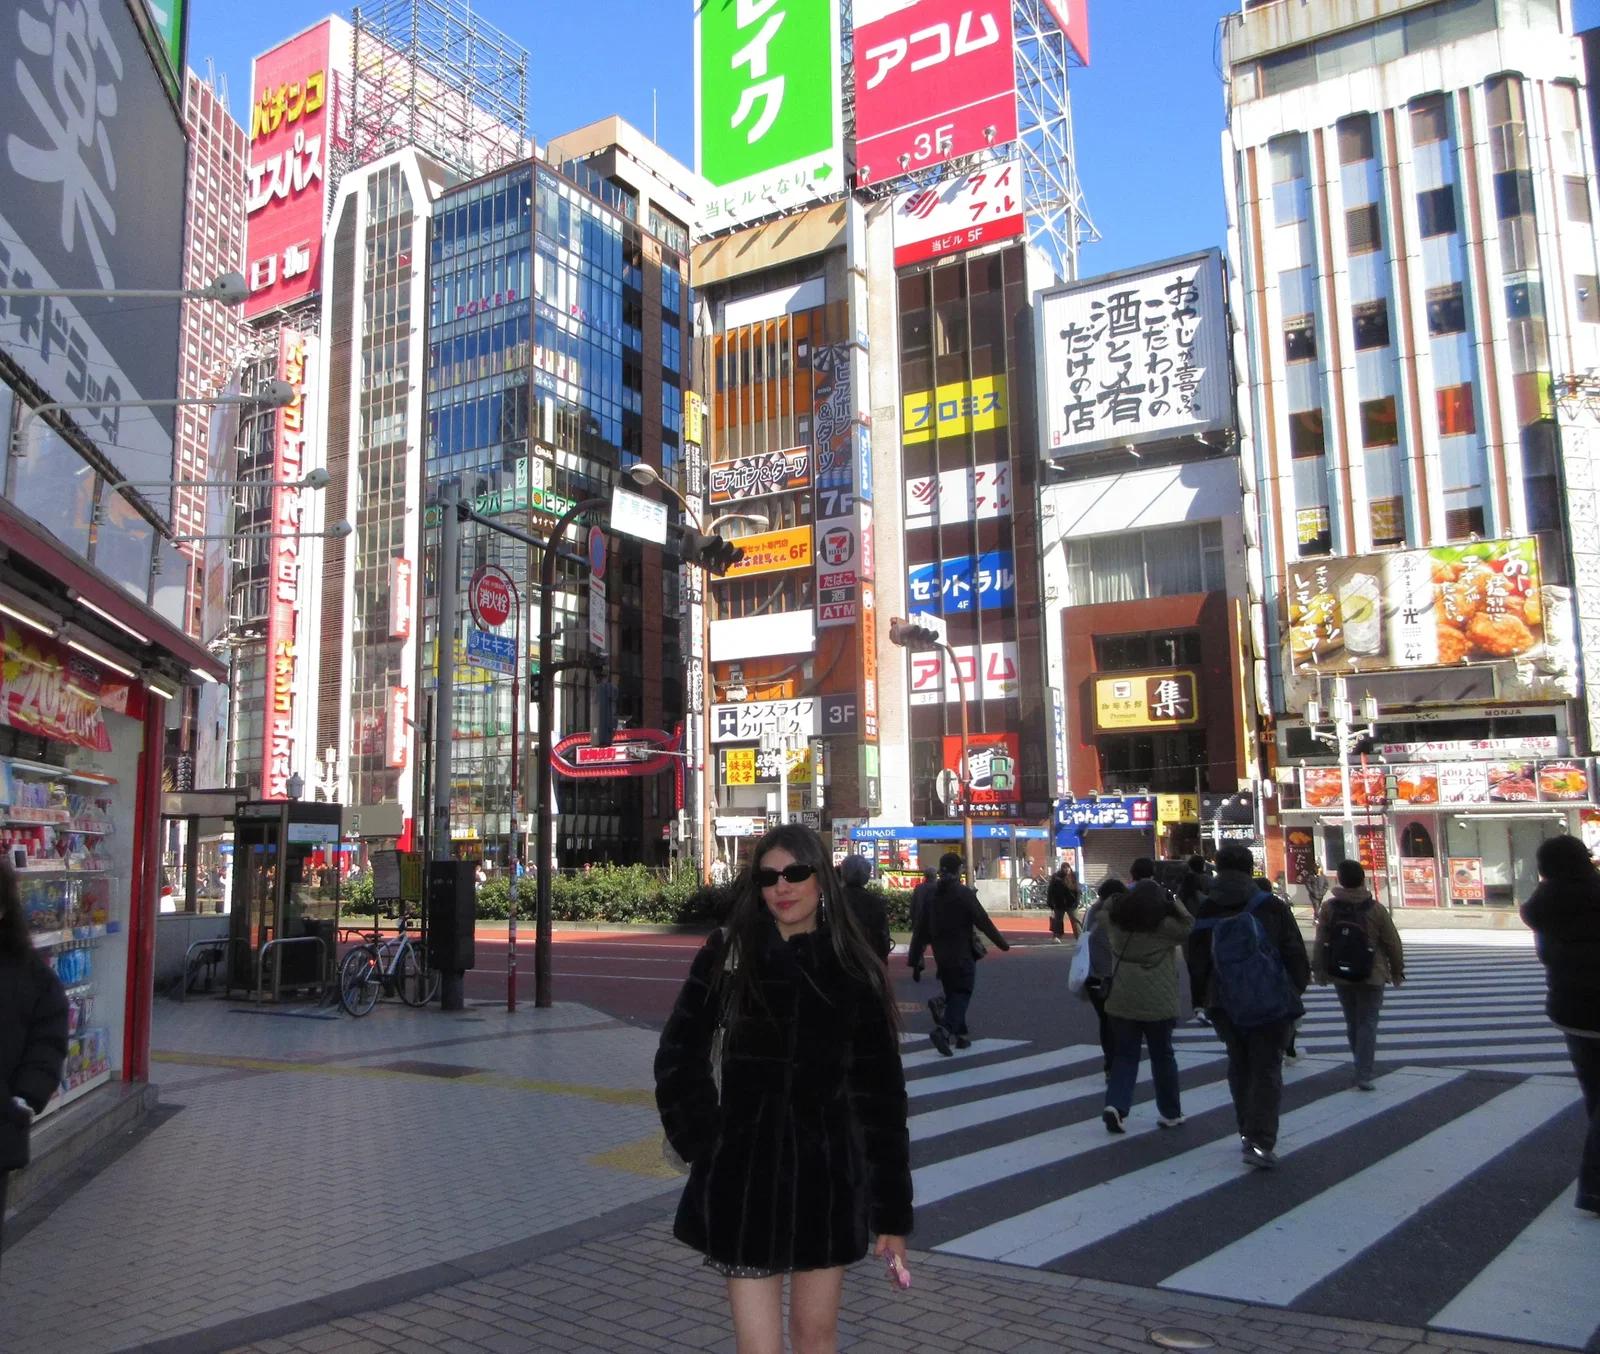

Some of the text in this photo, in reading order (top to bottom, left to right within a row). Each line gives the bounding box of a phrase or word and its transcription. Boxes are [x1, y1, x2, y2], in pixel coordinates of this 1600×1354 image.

[866, 10, 999, 90] アコム
[252, 69, 325, 141] パチンコ
[914, 124, 954, 160] 3F
[246, 129, 322, 213] エスパス
[704, 170, 808, 220] 当ビルとなり
[931, 228, 983, 253] 当ビル 5F
[457, 289, 516, 318] POKER
[1090, 290, 1146, 425] 酒と肴
[1142, 300, 1173, 417] こだわりの
[1060, 322, 1097, 436] だけの店
[912, 392, 1002, 427] プロミス
[820, 491, 852, 518] 7F
[789, 543, 808, 559] 6F
[824, 573, 853, 587] たばこ
[911, 568, 1014, 600] セントラル
[479, 588, 507, 613] 消火栓
[831, 589, 846, 602] 酒
[957, 600, 969, 609] 4F
[823, 604, 855, 618] ATM
[1402, 608, 1418, 625] 光
[1405, 649, 1423, 662] 4F
[273, 640, 293, 713] パチンコ
[914, 652, 1016, 688] アコム
[741, 702, 814, 720] メンズライフ
[920, 694, 935, 703] 3F
[1151, 680, 1190, 717] 集
[829, 706, 855, 723] 3F
[1484, 709, 1522, 717] MONJA
[741, 720, 800, 737] クリニク
[270, 720, 292, 796] エスパス
[856, 829, 897, 837] SUBNADE
[860, 844, 868, 855] P
[1453, 889, 1482, 898] ¥590
